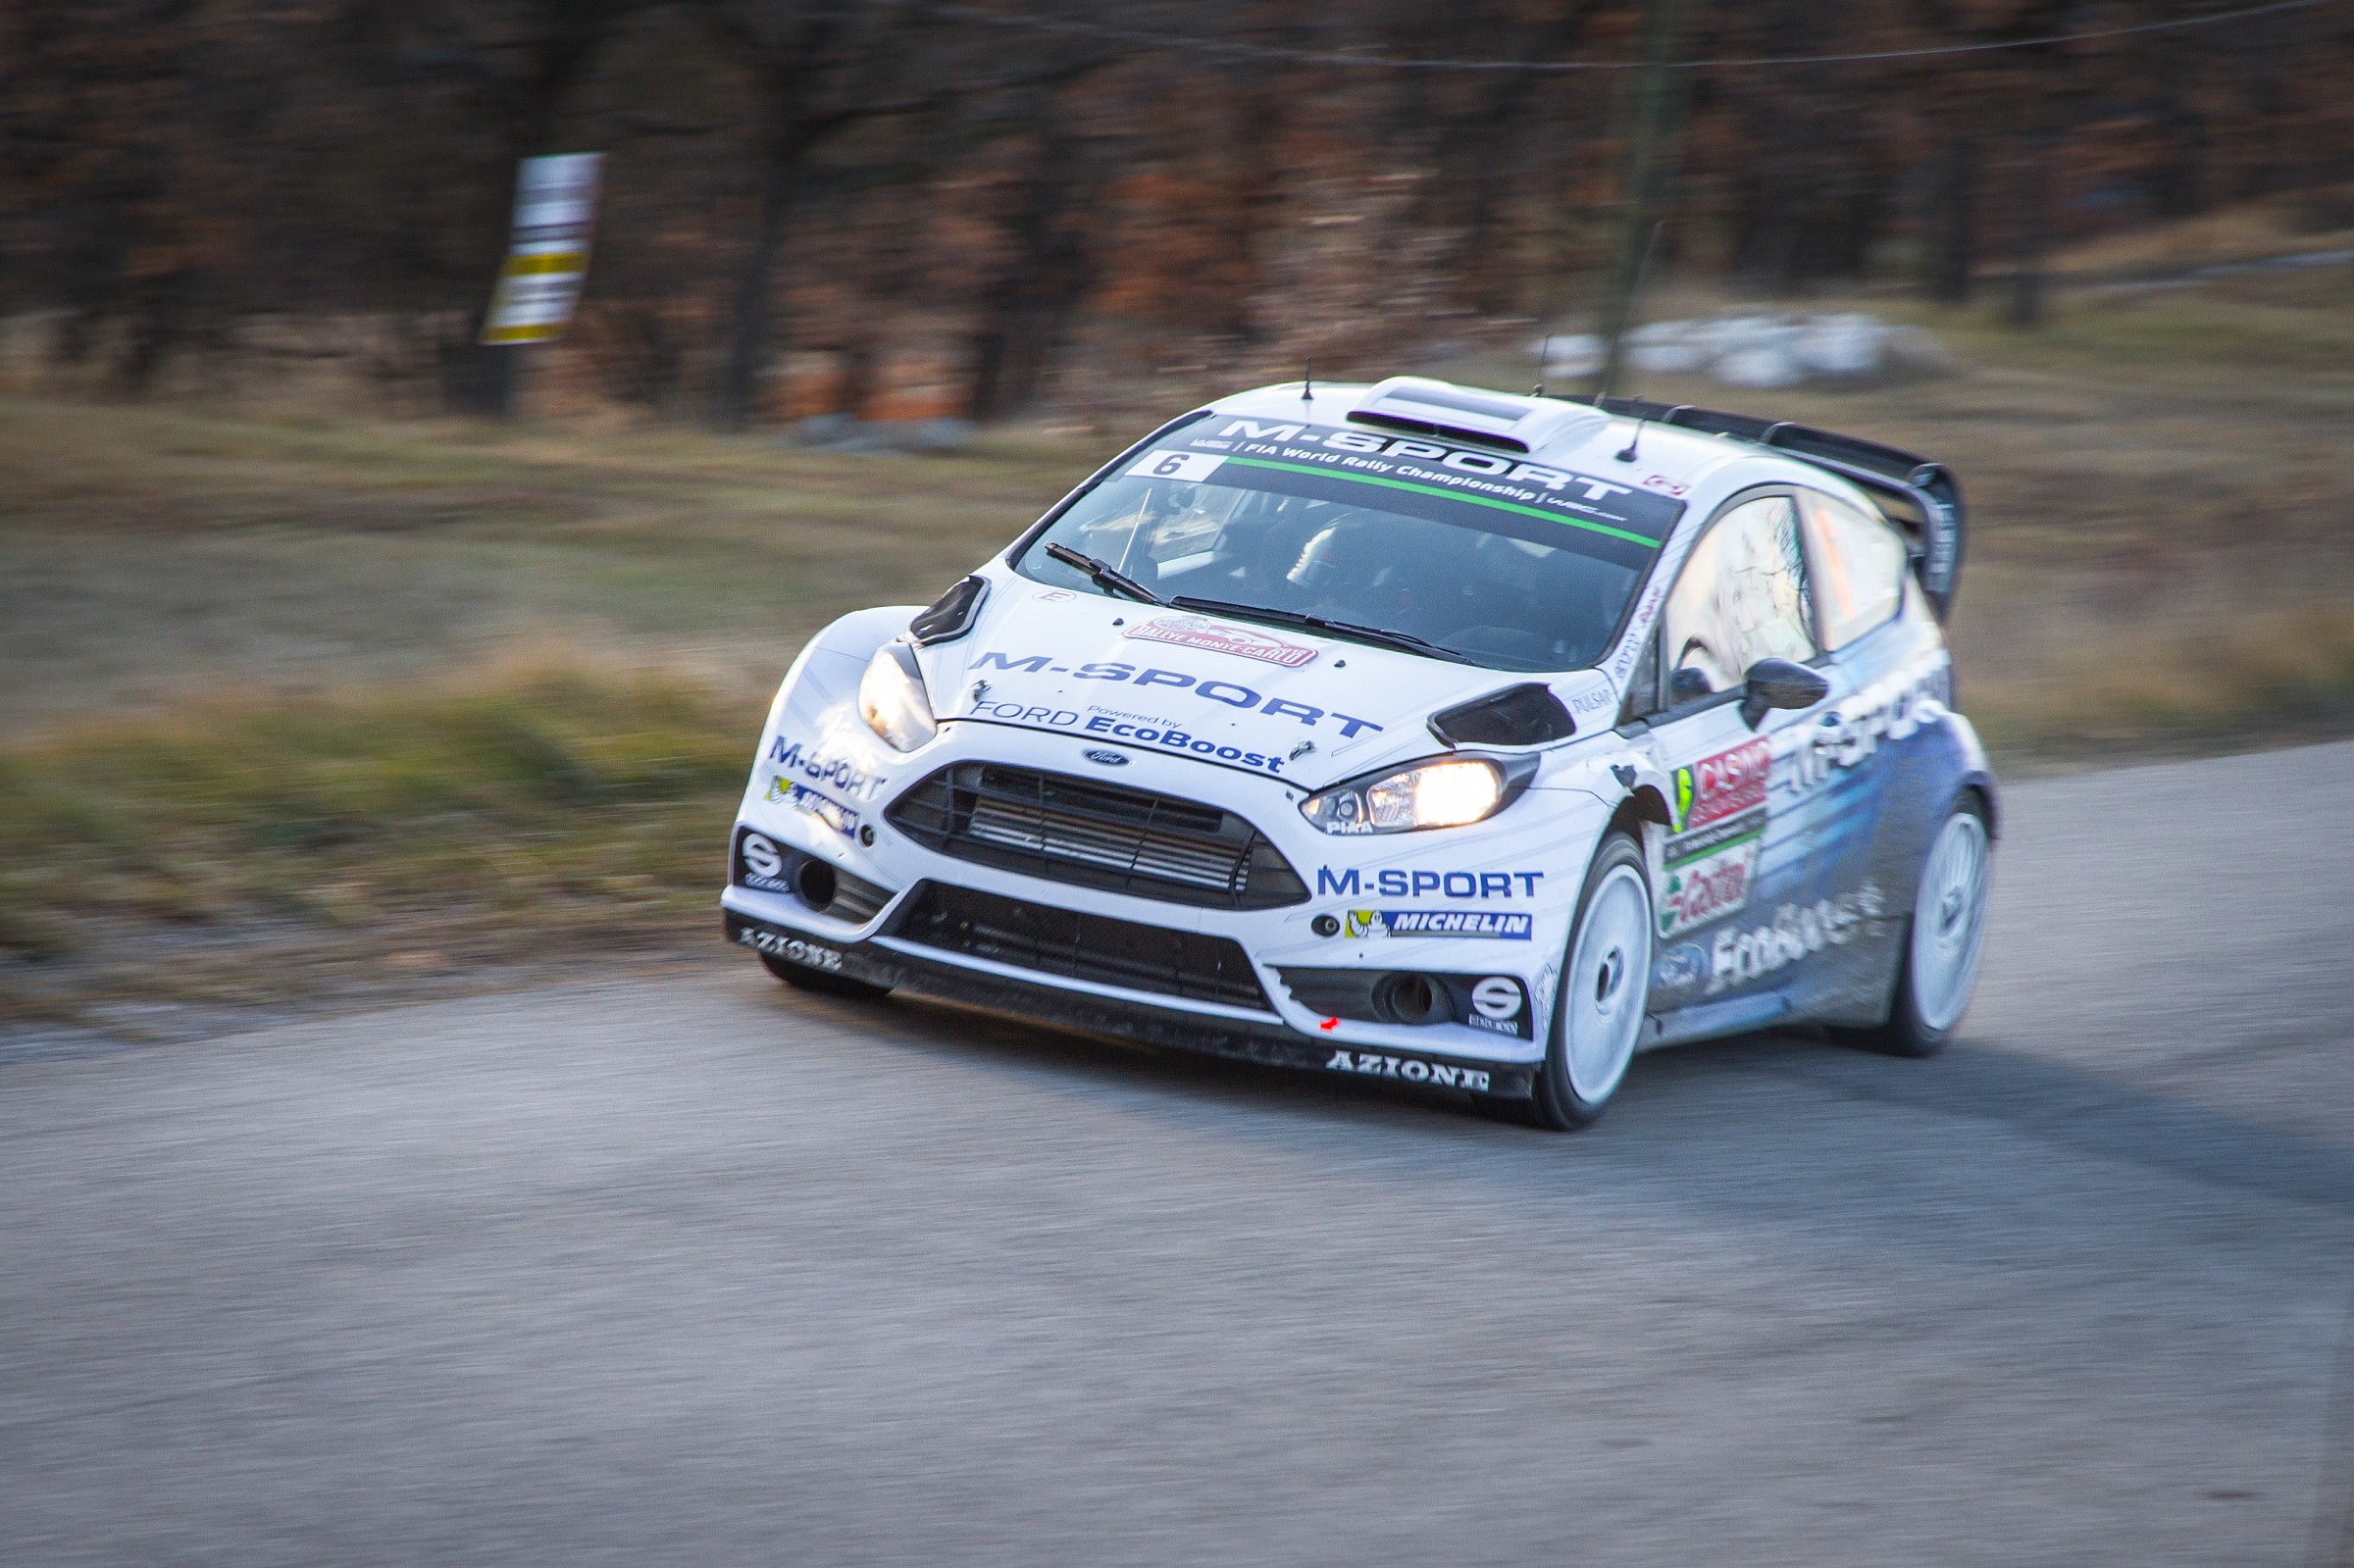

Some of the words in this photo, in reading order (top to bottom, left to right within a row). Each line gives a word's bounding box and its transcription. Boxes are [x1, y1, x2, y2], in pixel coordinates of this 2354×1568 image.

[1152, 454, 1191, 476] 6
[1218, 420, 1633, 501] M-SPORT
[1244, 443, 1278, 456] FIA
[1283, 448, 1342, 466] World
[1341, 455, 1394, 474] Rally
[1395, 464, 1538, 501] Championship
[1040, 591, 1065, 602] E
[1135, 625, 1188, 641] RALLYE
[1188, 636, 1305, 665] MONTE-CARLO
[967, 651, 1384, 738] M-SPORT
[968, 700, 1079, 728] FORD
[1084, 715, 1286, 774] EcoBoost
[1087, 704, 1159, 726] Powered
[1161, 718, 1182, 732] by
[768, 734, 890, 802] M-SPORT
[1325, 821, 1375, 835] PIAA
[1316, 867, 1545, 899] M-SPORT
[1393, 912, 1529, 935] MICHELIN
[1325, 1049, 1490, 1092] AZIONE
